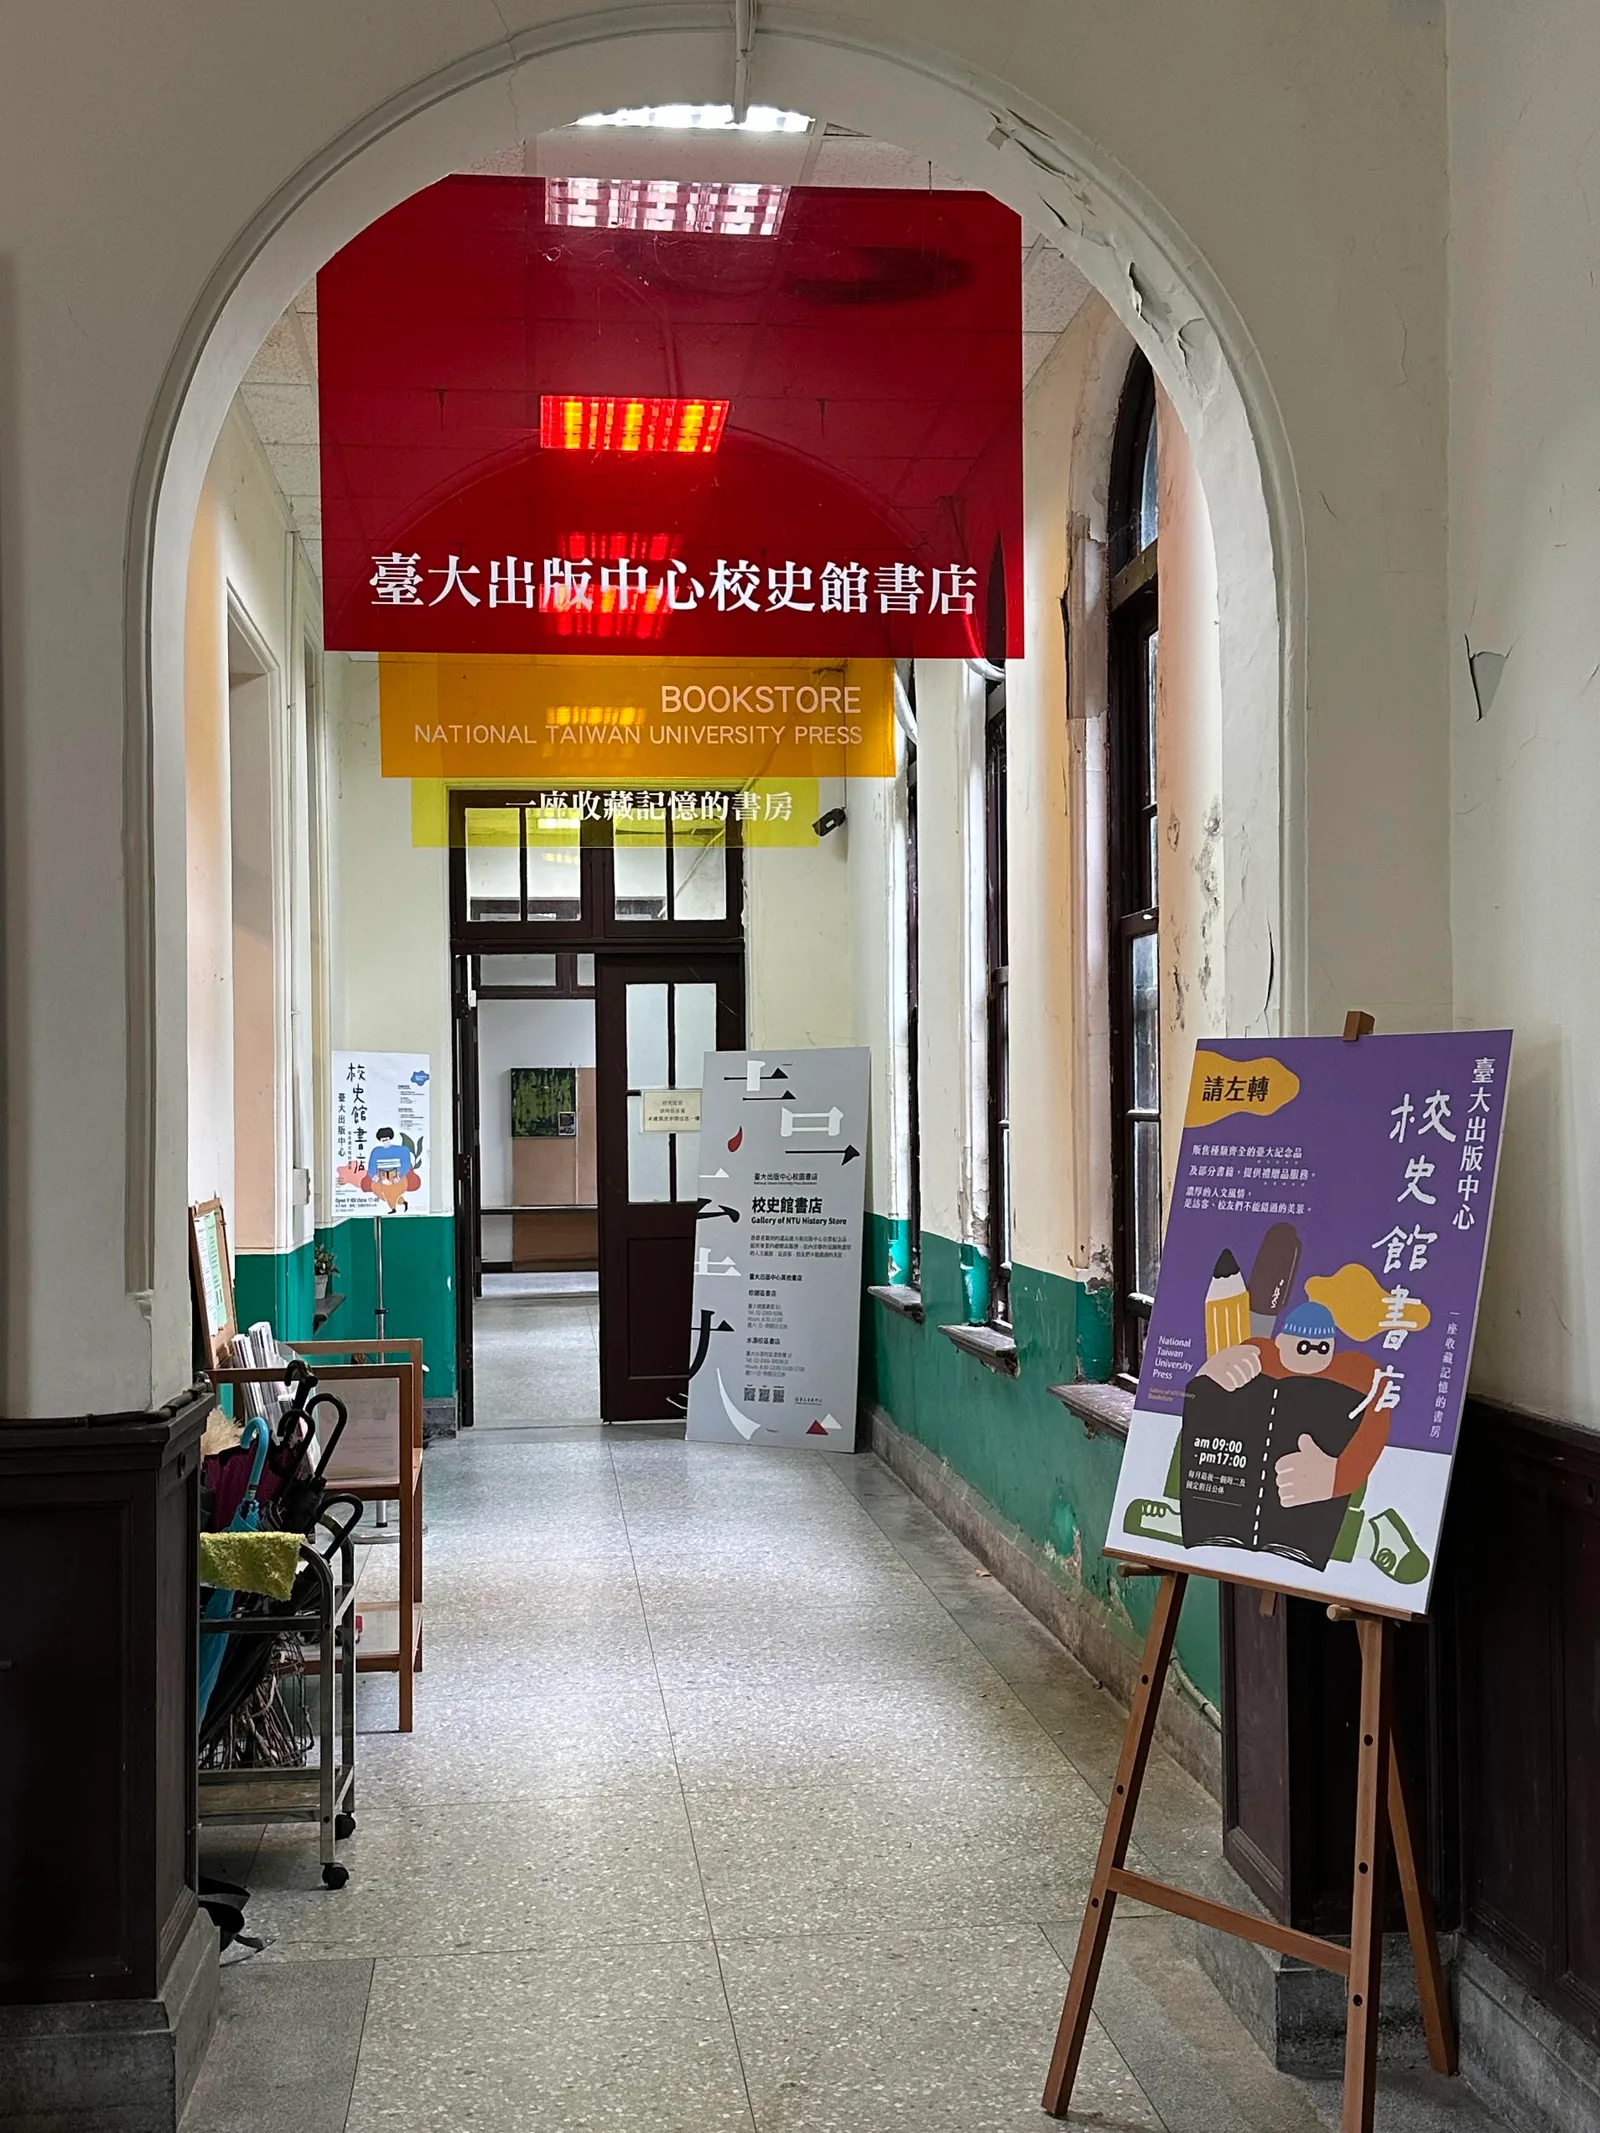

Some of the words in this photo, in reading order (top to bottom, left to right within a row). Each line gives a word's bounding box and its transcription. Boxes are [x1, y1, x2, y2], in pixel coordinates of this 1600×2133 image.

[368, 551, 978, 615] 臺大出版中心校史館書店
[661, 685, 861, 714] BOOKSTORE
[414, 724, 537, 744] NATIONAL
[545, 724, 640, 745] TAIWAN
[649, 725, 784, 745] UNIVERSITY
[795, 726, 863, 746] PRESS
[504, 790, 793, 823] 一座收藏記憶的書房
[1201, 1074, 1270, 1104] 請左轉
[1451, 1056, 1496, 1231] 臺大出版中心
[752, 1196, 823, 1214] 校史館書店
[751, 1217, 776, 1225] Gallery
[777, 1216, 785, 1224] of
[786, 1217, 801, 1225] NTU
[802, 1217, 827, 1226] History
[828, 1217, 847, 1225] Store
[1348, 1089, 1457, 1420] 校史館書店
[1158, 1335, 1191, 1348] National
[1157, 1346, 1184, 1358] Taiwan
[1152, 1368, 1173, 1380] Press
[1154, 1358, 1194, 1373] University
[1430, 1311, 1460, 1439] 一座收藏記憶的書房
[1193, 1438, 1210, 1450] am
[1212, 1438, 1243, 1454] 09:00
[1198, 1453, 1247, 1469] pm17:00
